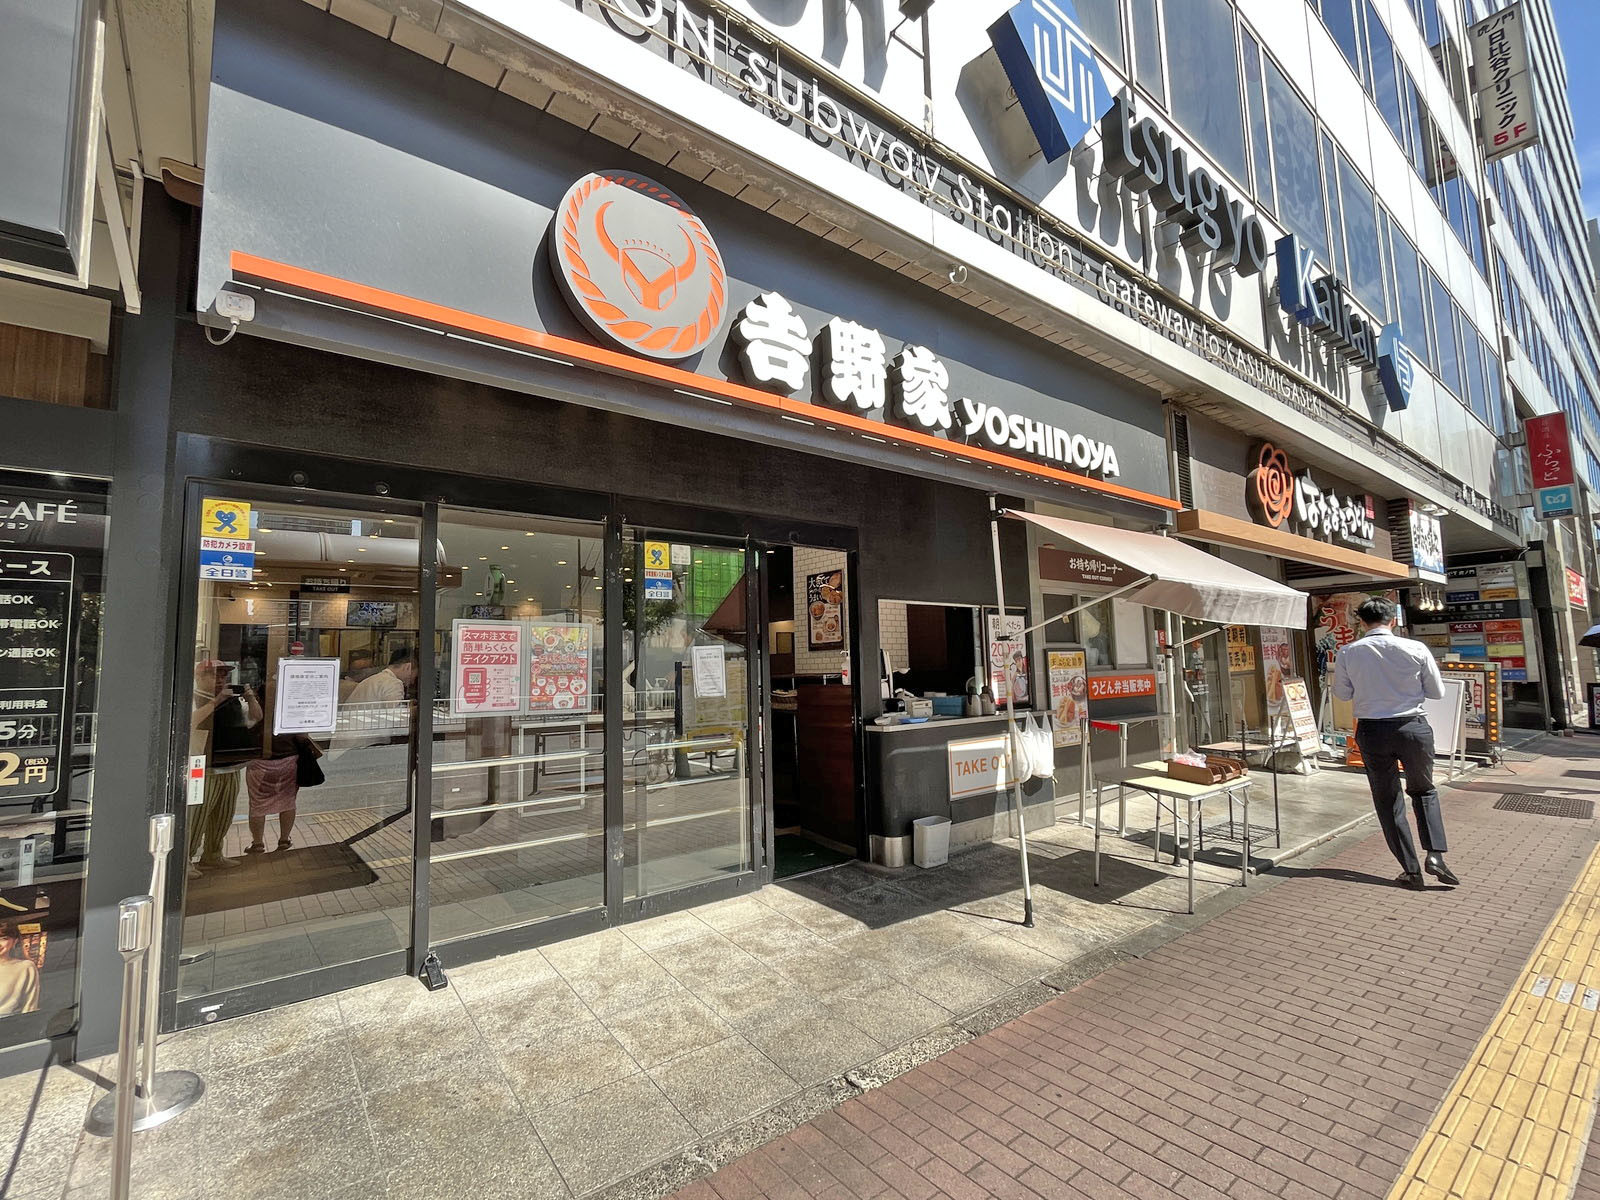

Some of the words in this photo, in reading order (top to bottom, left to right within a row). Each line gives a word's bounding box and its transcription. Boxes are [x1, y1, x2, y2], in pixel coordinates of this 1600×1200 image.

[1477, 10, 1515, 37] 虎ノ門
[1488, 28, 1518, 129] 日比谷クリニック
[748, 53, 940, 192] subway
[958, 173, 1073, 268] Station
[1102, 261, 1195, 346] Gateway
[1202, 326, 1219, 355] to
[1225, 335, 1322, 416] KASUMIGASEKI
[740, 291, 952, 430] 吉野家
[962, 397, 1120, 478] YOSHINOYA
[1295, 468, 1375, 540] はなまるうどん
[202, 540, 253, 551] 防犯カメラ設置
[0, 559, 51, 576] ース
[1069, 557, 1123, 574] お持ち帰りコーナー
[463, 631, 517, 641] スマホ注文で
[463, 642, 515, 653] 簡単らくらく
[463, 654, 516, 664] テイクアウト
[1092, 678, 1151, 696] うどん弁当販売中
[955, 757, 988, 777] TAKE
